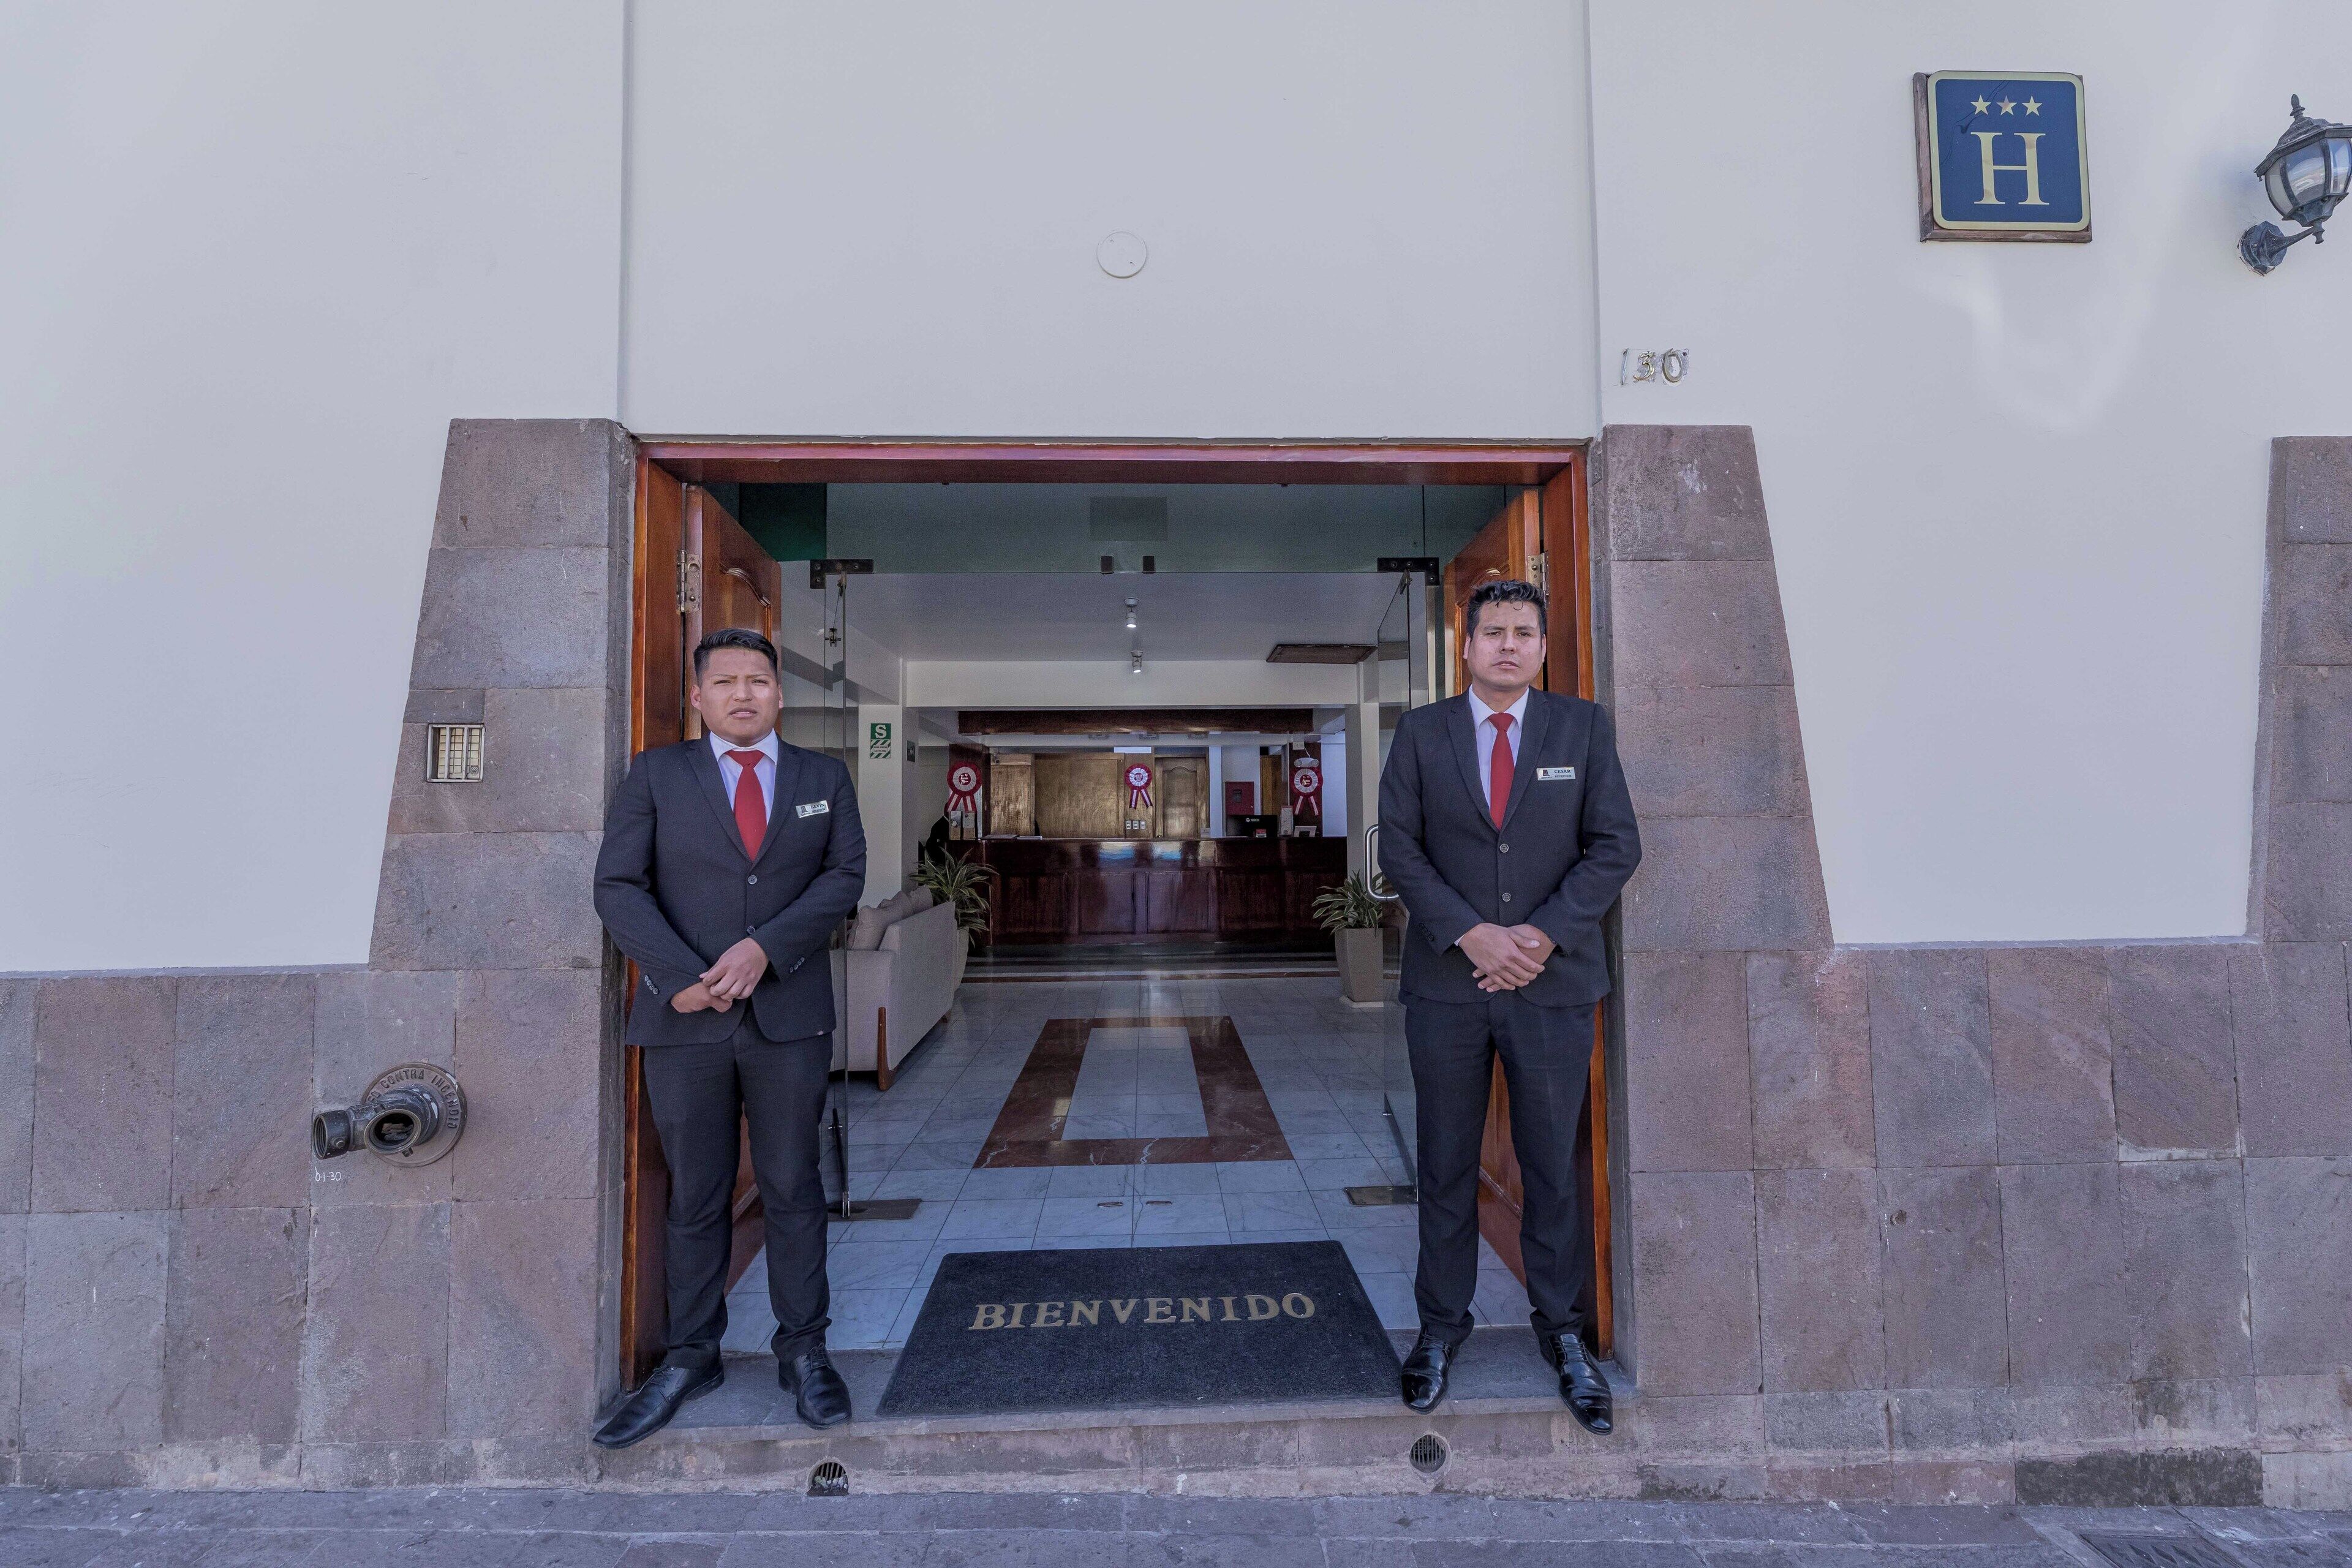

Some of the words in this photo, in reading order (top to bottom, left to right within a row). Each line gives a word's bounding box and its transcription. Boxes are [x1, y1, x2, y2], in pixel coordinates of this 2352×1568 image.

[1970, 132, 2050, 205] H
[875, 724, 887, 739] S
[380, 1068, 424, 1089] CONTRA
[431, 1074, 459, 1129] INCENDIO
[968, 1292, 1316, 1330] BIENVENIDO
